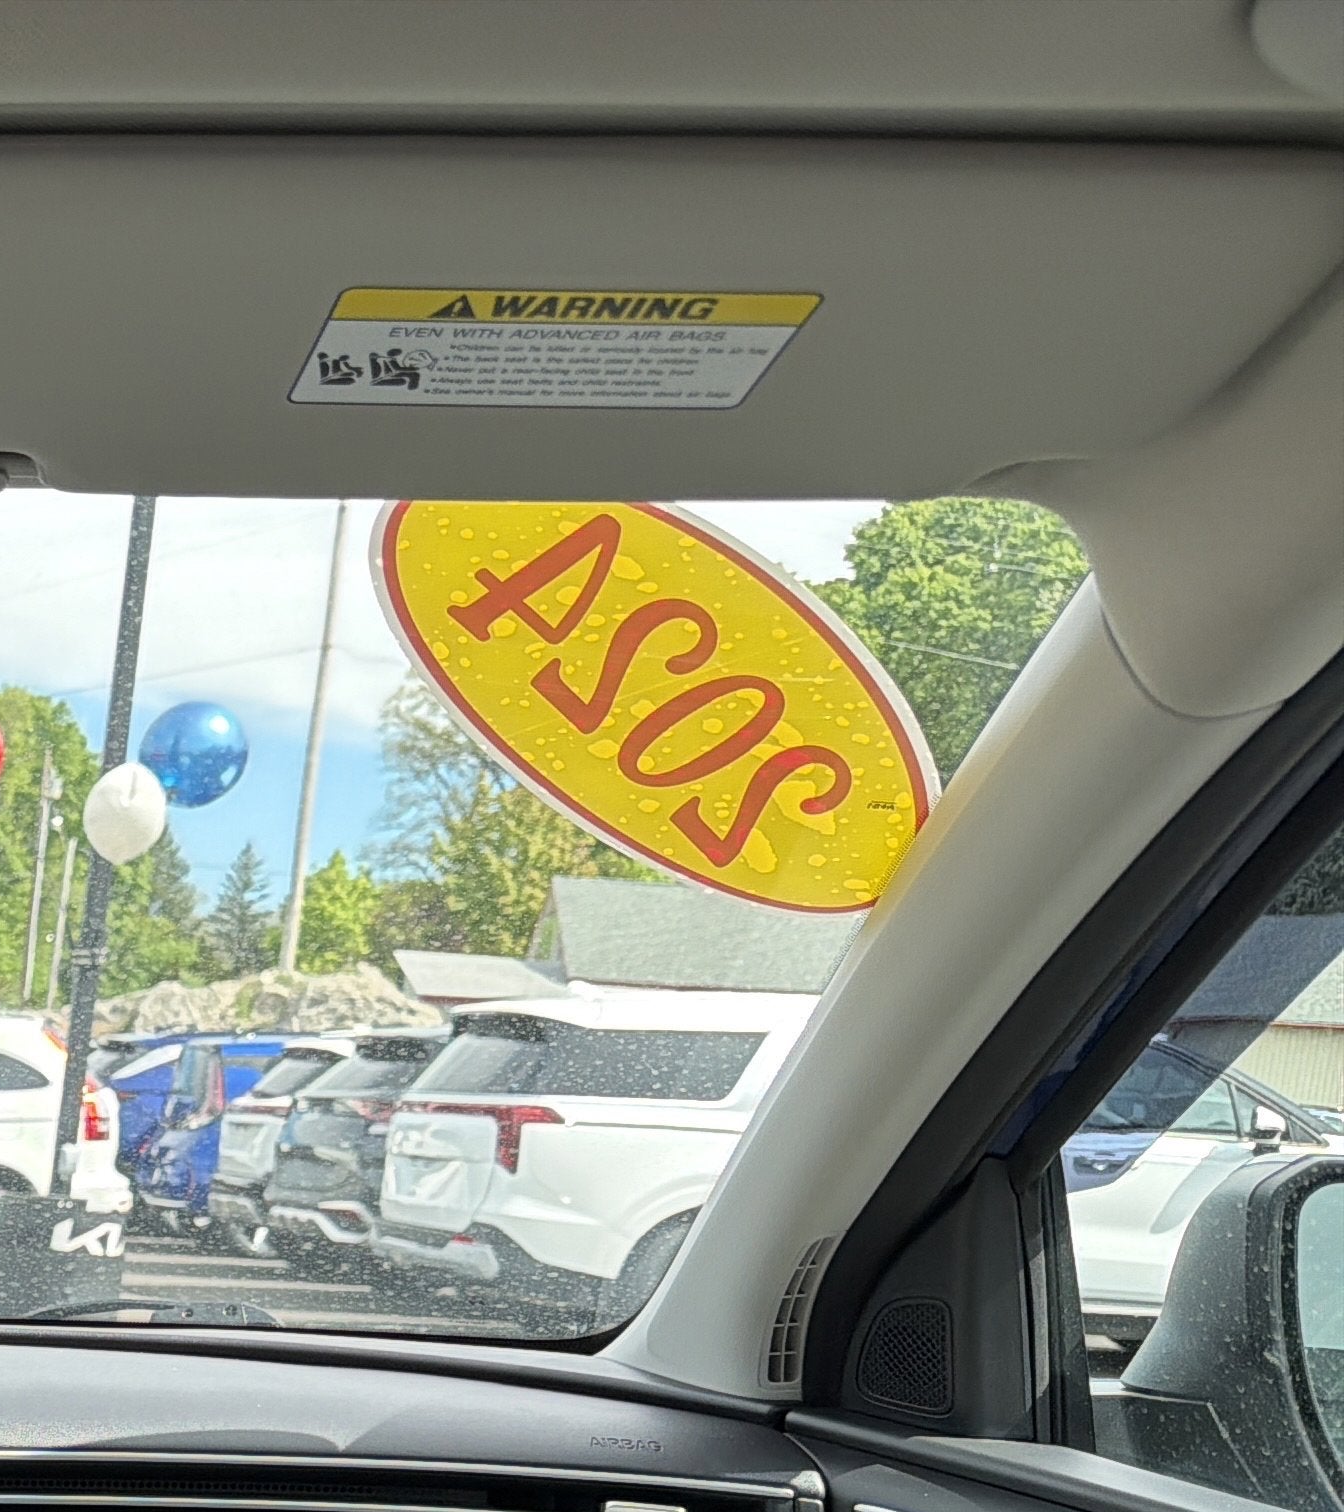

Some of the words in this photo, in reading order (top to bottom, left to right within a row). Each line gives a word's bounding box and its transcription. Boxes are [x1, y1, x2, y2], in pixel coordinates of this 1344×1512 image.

[491, 295, 719, 320] WARNING
[389, 327, 444, 339] EVEN
[452, 328, 504, 340] WITH
[509, 328, 621, 342] ADVANCED
[626, 330, 661, 342] AIR
[669, 331, 728, 343] BAGS
[590, 1436, 663, 1452] AIRBAG
